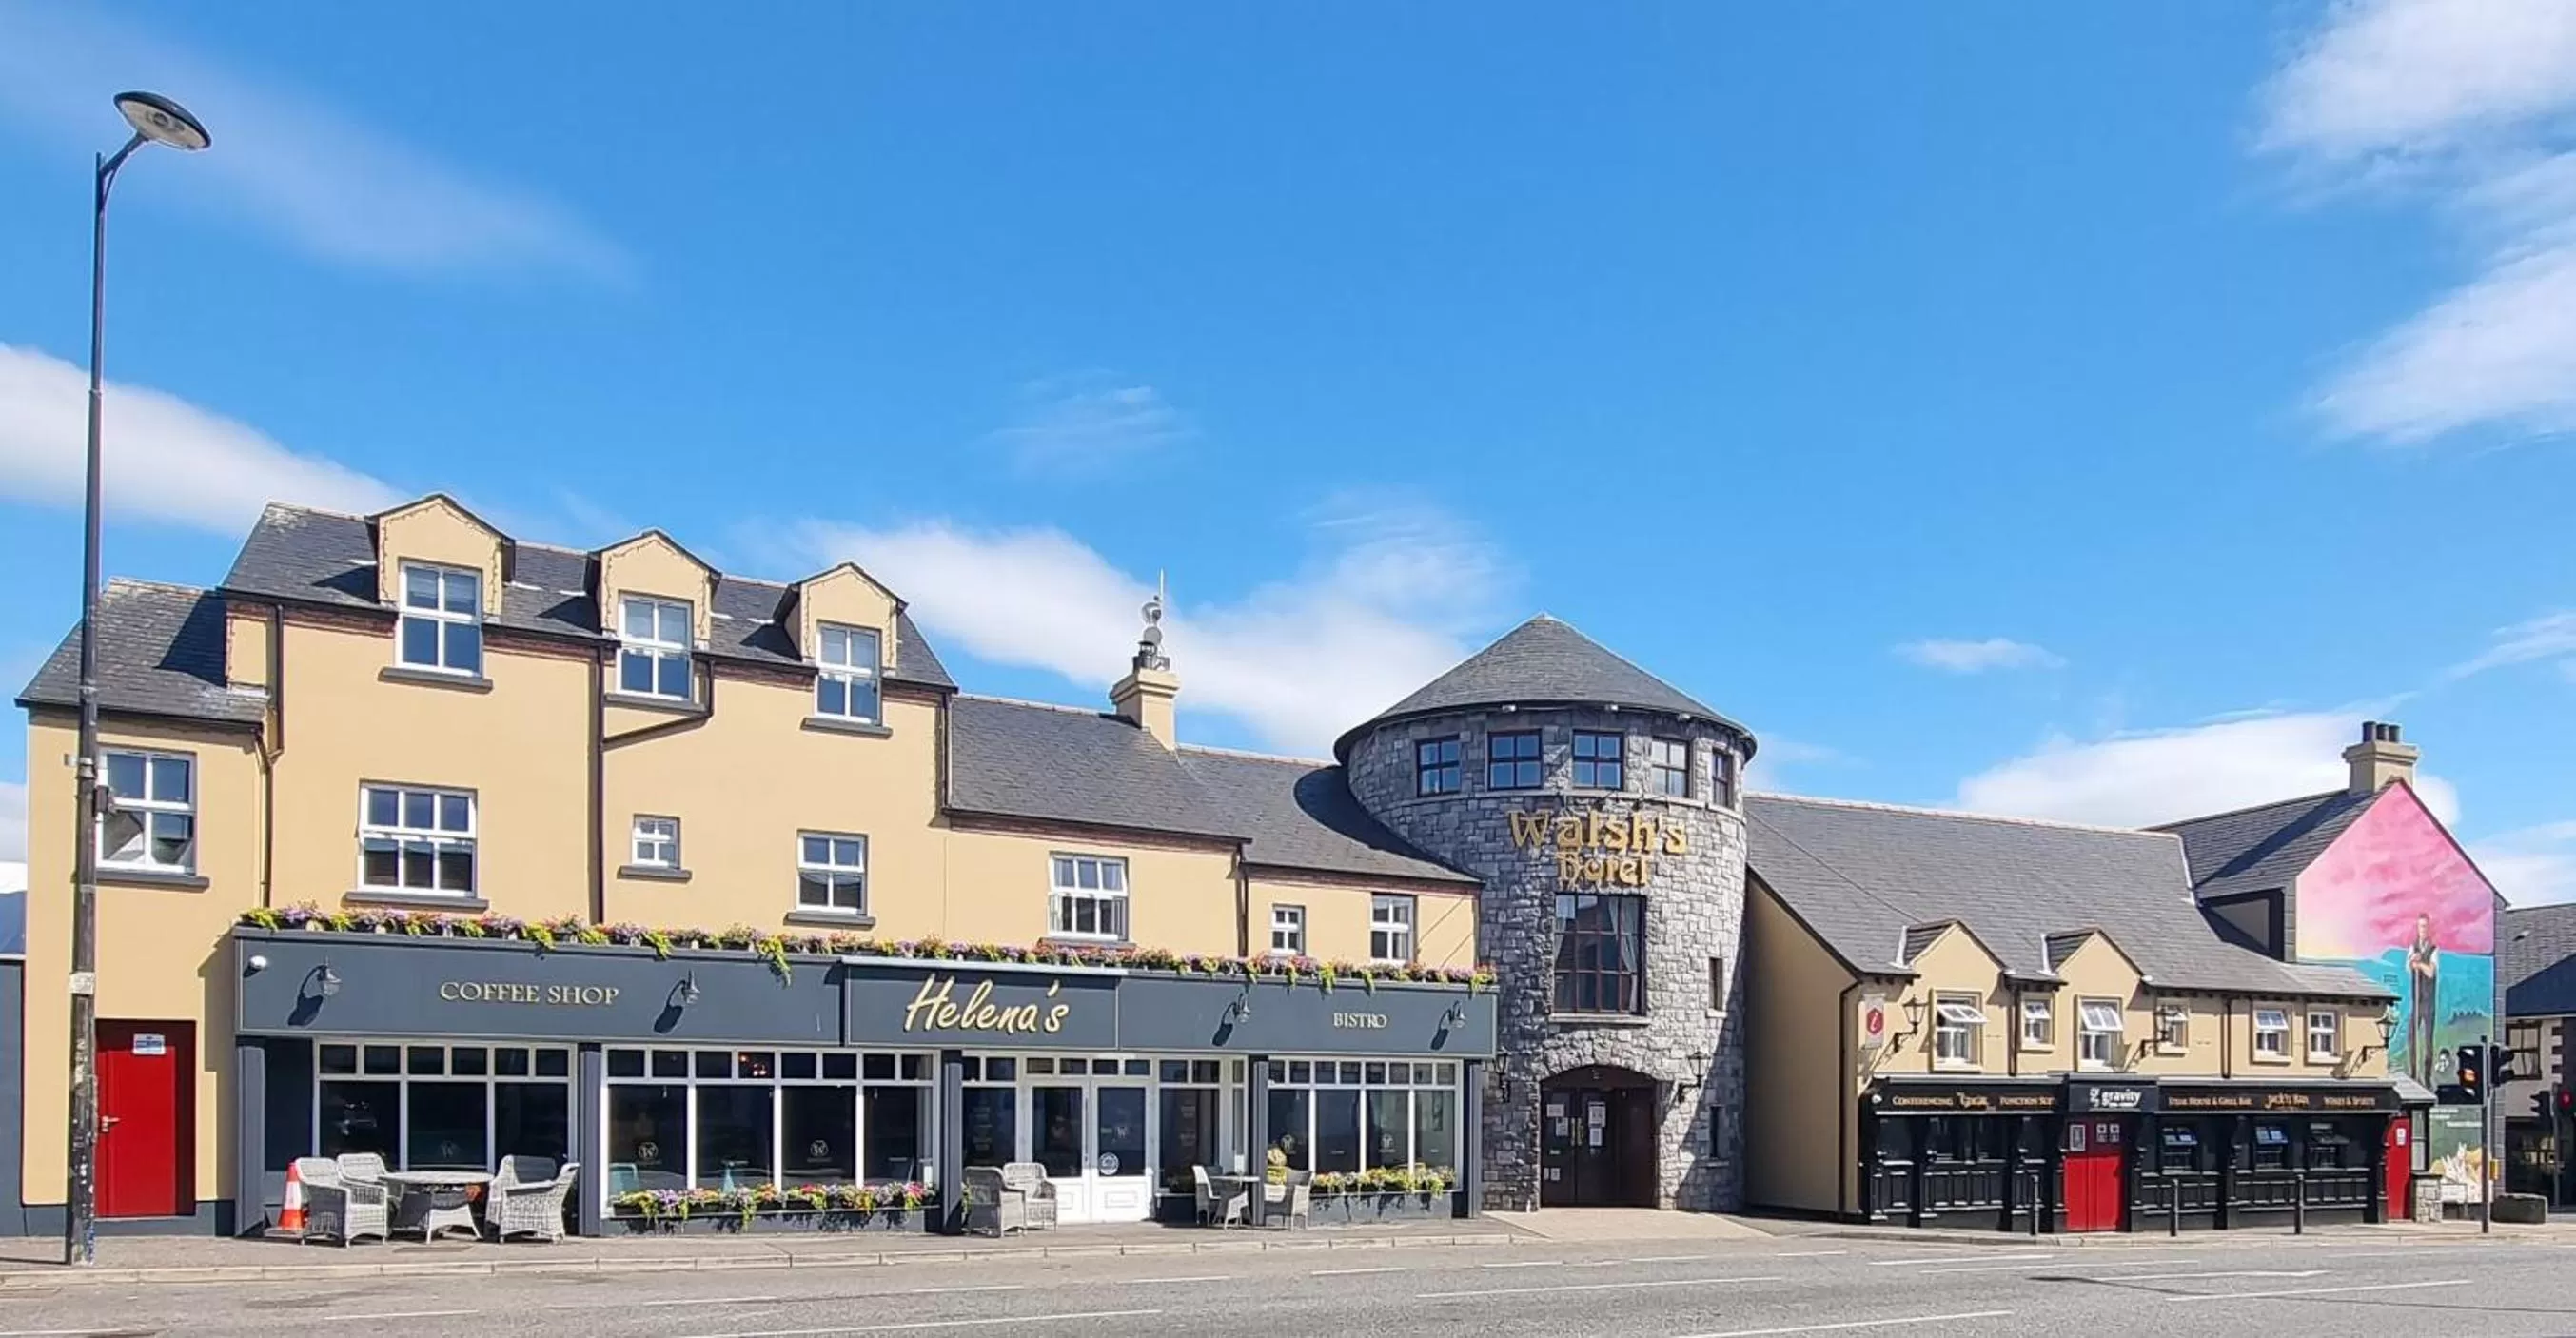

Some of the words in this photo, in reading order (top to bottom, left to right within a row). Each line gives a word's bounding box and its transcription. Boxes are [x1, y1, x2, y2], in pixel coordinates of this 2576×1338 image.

[1506, 807, 1688, 856] Walsh's
[440, 981, 540, 1002] COFFEE
[547, 985, 619, 1005] SHOP
[903, 972, 1070, 1034] Helena's
[1333, 1012, 1387, 1028] BISTRO
